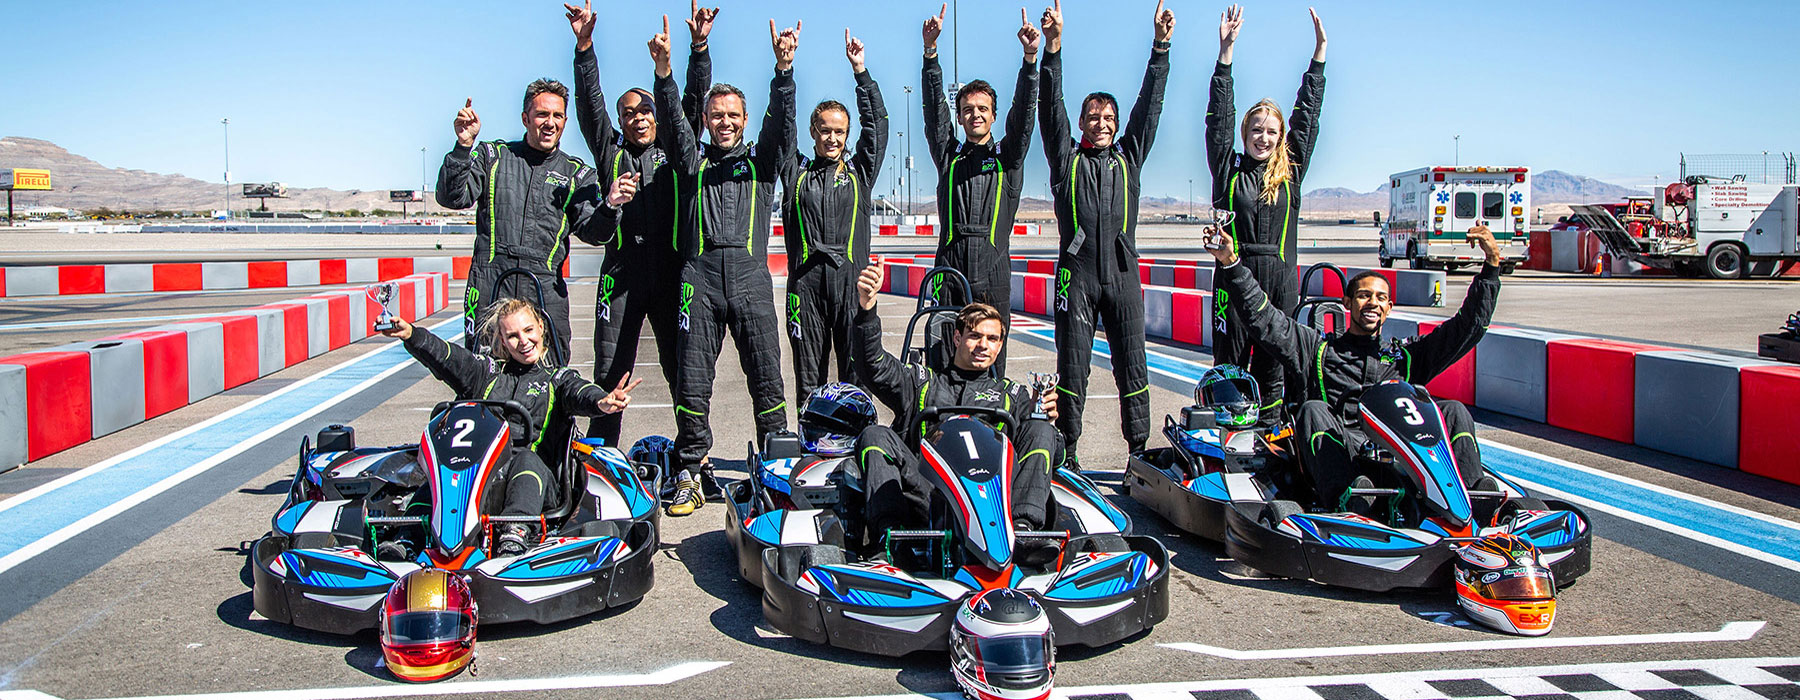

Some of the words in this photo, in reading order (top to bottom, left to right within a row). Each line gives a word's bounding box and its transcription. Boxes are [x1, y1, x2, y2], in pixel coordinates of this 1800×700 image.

[16, 172, 49, 185] PIRELLI
[599, 274, 615, 322] EXR
[680, 282, 694, 332] EXR
[1058, 267, 1071, 312] EXR
[466, 287, 479, 336] EXR
[790, 292, 802, 340] EXR
[1216, 288, 1228, 335] EXR
[1394, 397, 1424, 425] 3
[451, 419, 475, 447] 2
[959, 431, 979, 459] 1
[962, 607, 976, 621] EXR
[1519, 613, 1549, 623] EXR
